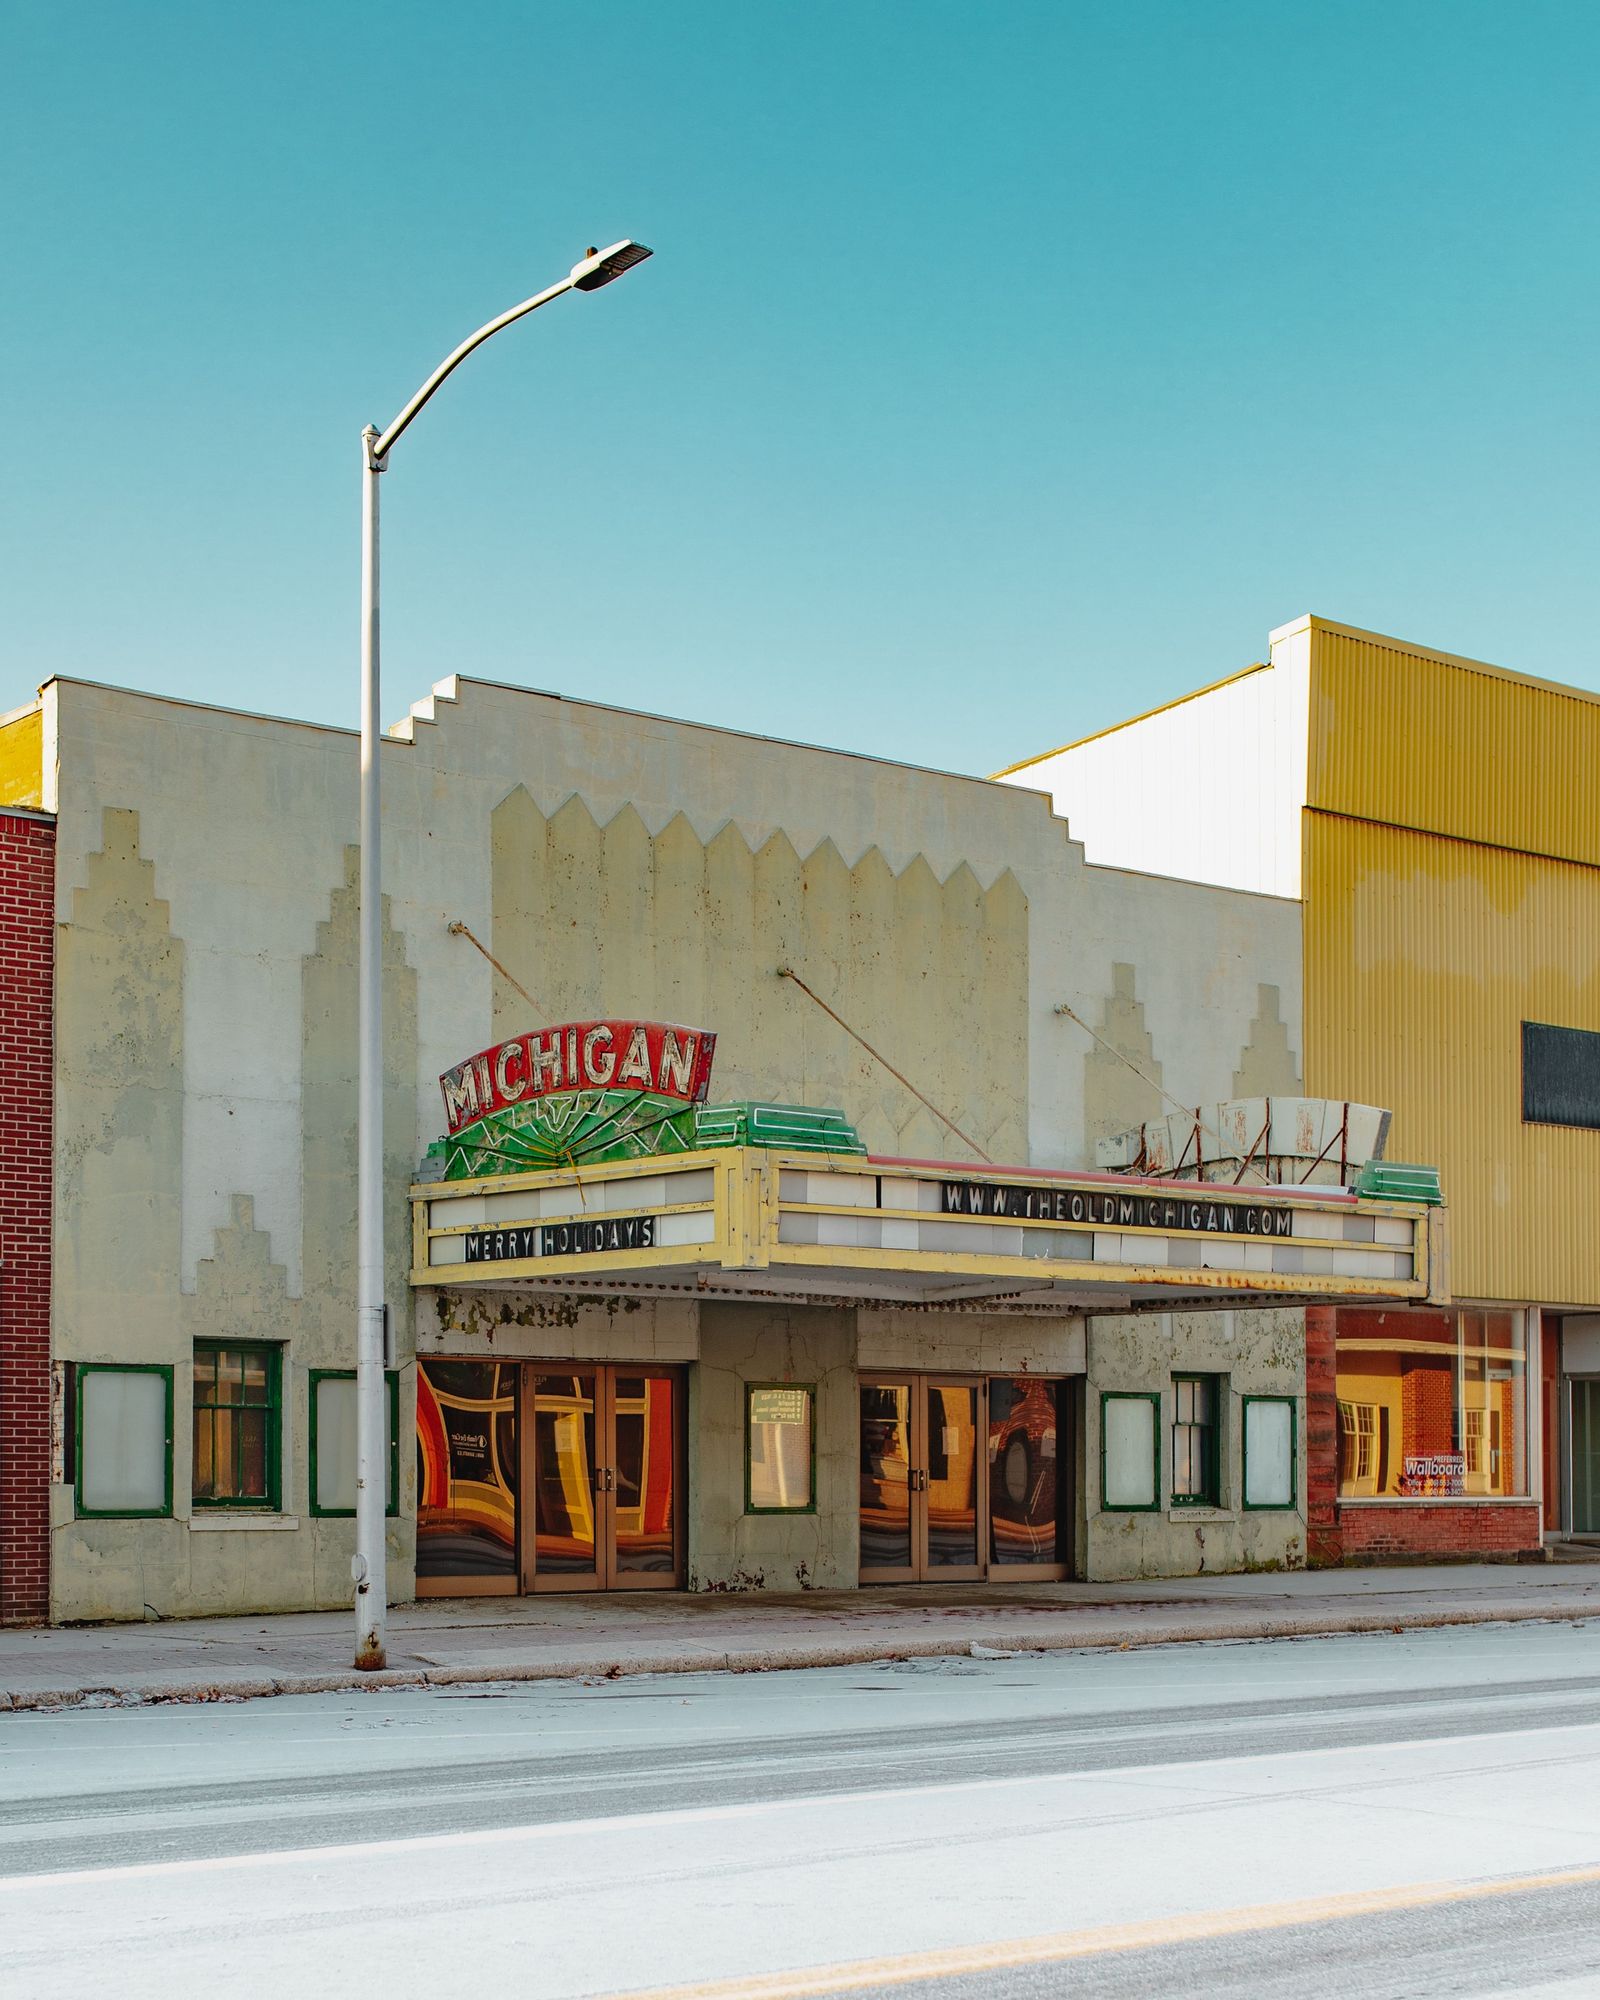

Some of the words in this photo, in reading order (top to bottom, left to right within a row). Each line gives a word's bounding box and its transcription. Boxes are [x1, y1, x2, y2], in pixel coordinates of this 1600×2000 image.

[441, 1025, 696, 1126] MICHIGAN
[467, 1230, 533, 1260] MERRY
[545, 1218, 652, 1255] HOLIDAYS
[1406, 1460, 1465, 1475] Wallboard
